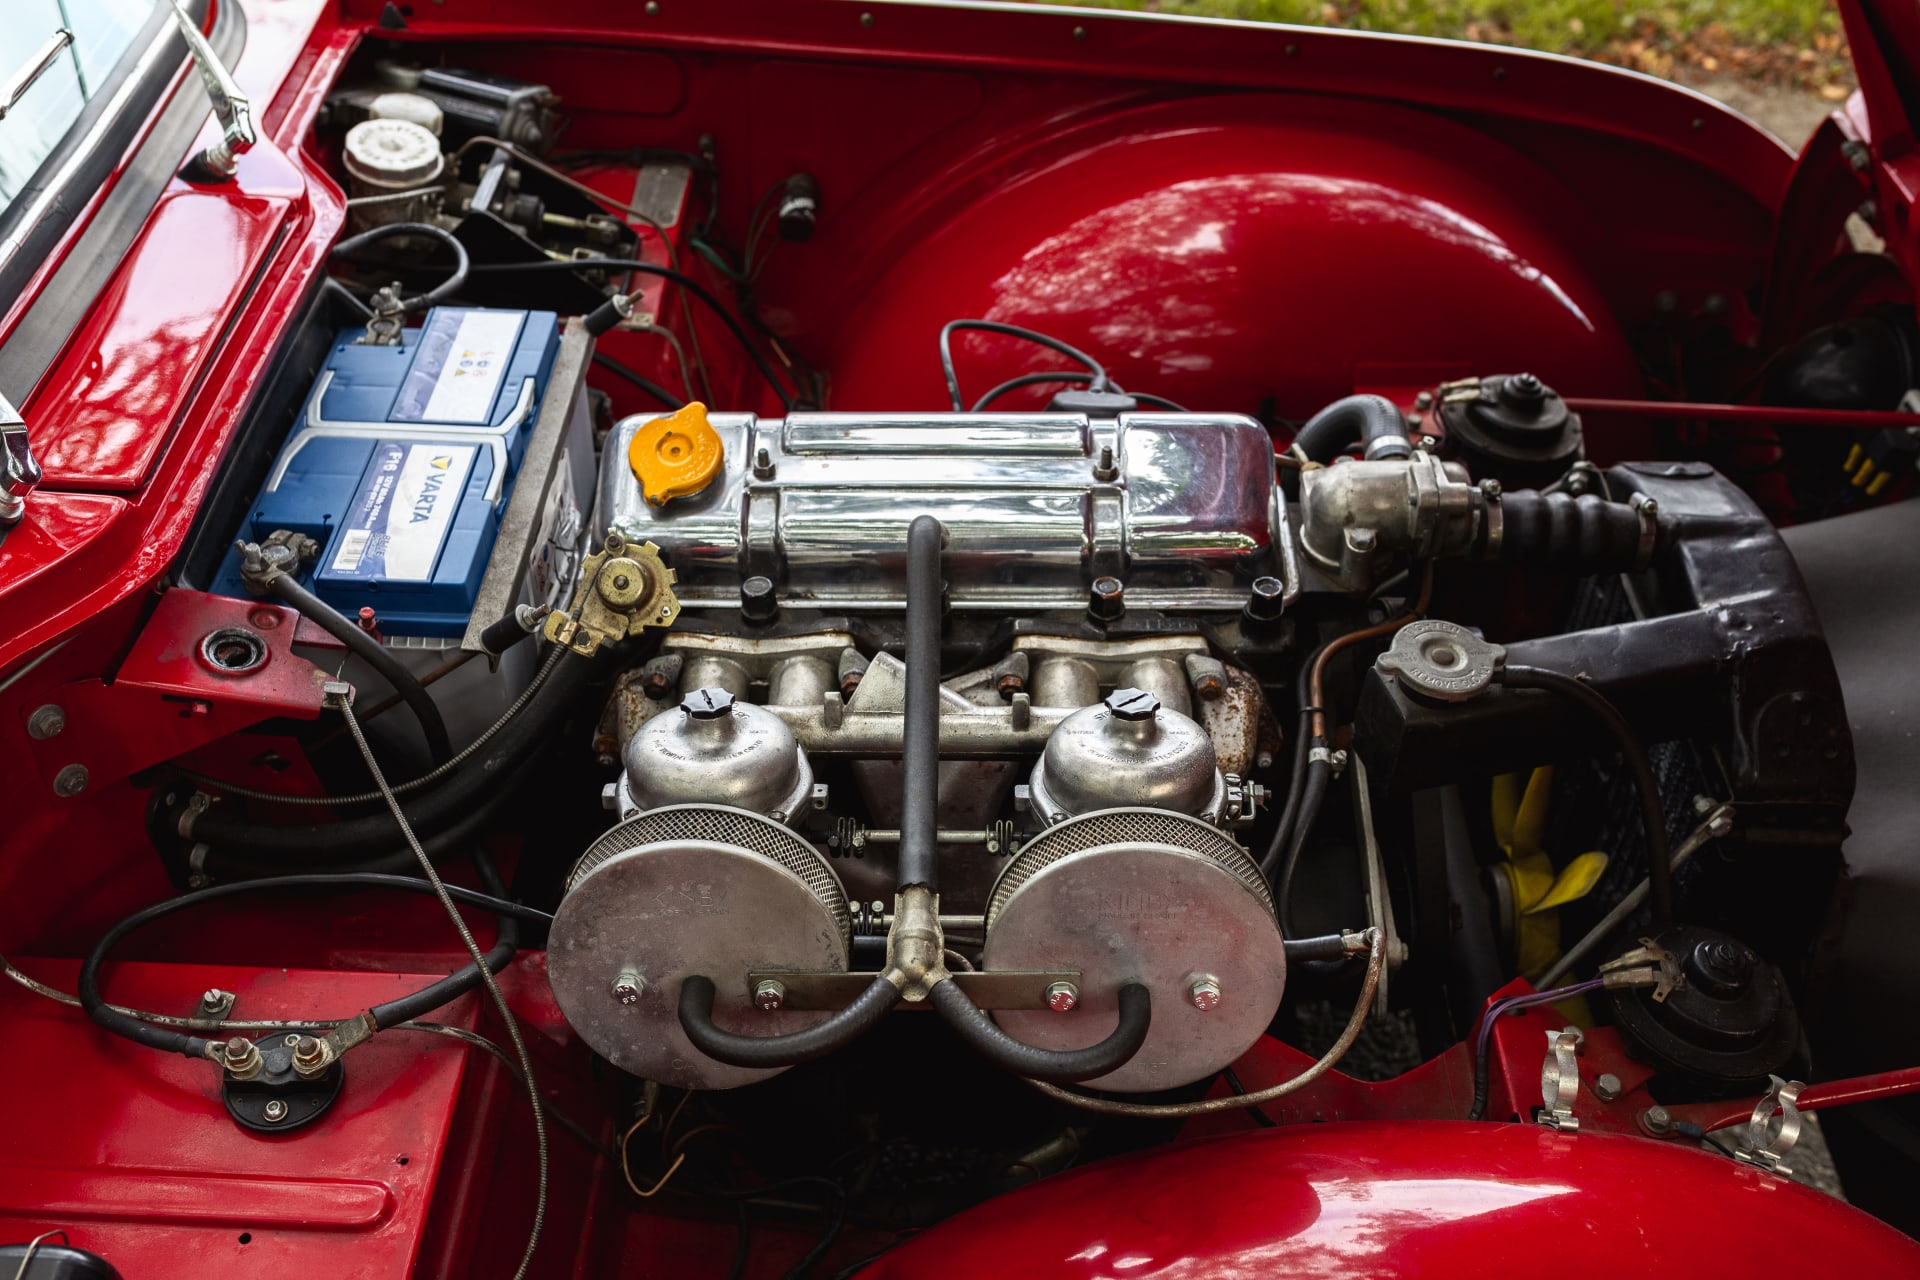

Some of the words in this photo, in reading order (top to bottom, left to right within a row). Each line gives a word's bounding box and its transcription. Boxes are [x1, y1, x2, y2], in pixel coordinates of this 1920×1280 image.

[383, 452, 403, 472] F16
[409, 473, 446, 524] VARTA
[1410, 668, 1458, 689] REMOVE
